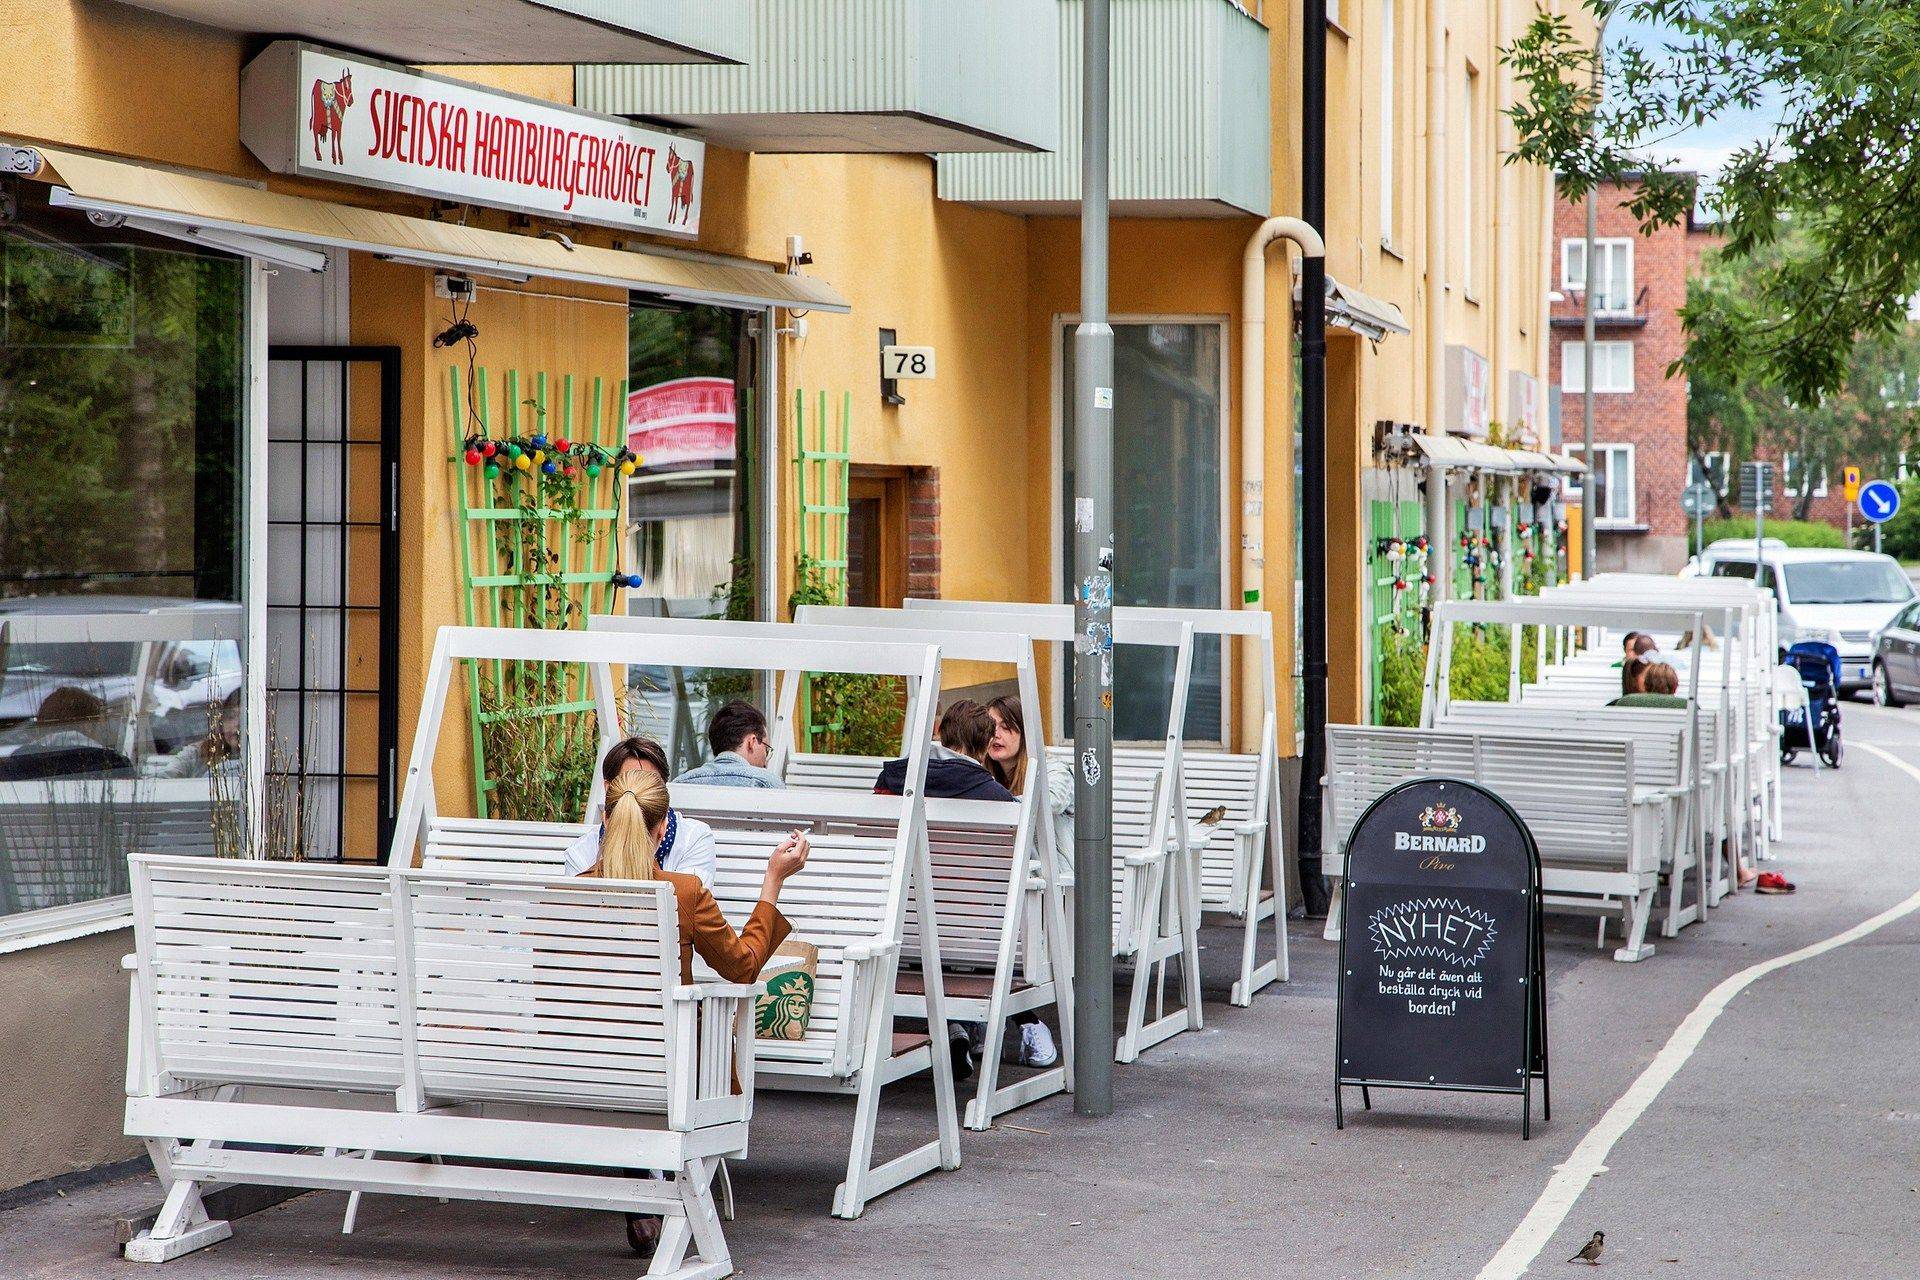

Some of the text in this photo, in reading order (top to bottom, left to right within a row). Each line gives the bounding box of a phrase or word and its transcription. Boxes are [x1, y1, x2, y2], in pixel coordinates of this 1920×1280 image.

[368, 88, 656, 211] SVENSKA HAMBURGERKÖKET
[894, 353, 926, 374] 78
[1395, 832, 1487, 853] BERNARD
[1378, 912, 1483, 949] NYHET
[1379, 965, 1482, 983] Nu går det även att
[1379, 981, 1482, 1000] beställa dryck vid
[1408, 999, 1456, 1016] borden!
